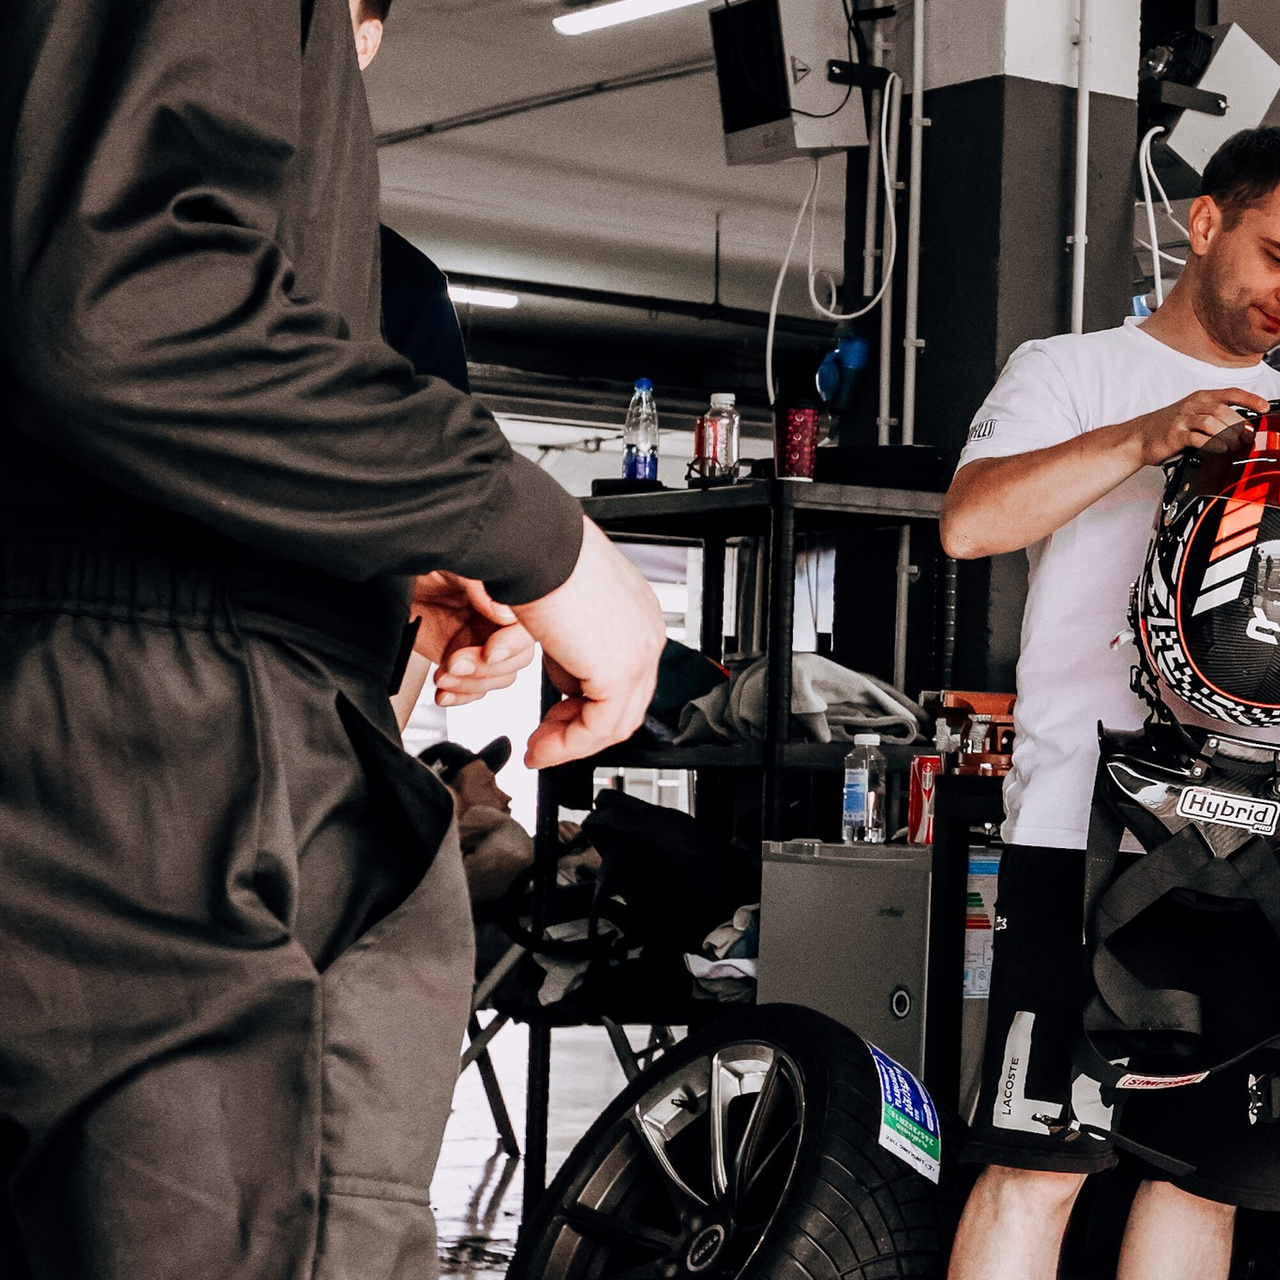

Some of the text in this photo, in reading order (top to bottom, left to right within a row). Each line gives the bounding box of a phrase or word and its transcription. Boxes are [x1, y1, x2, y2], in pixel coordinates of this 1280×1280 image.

[1188, 794, 1269, 823] Hybrid
[1253, 823, 1272, 832] PRO
[1002, 1056, 1020, 1116] LACOSTE
